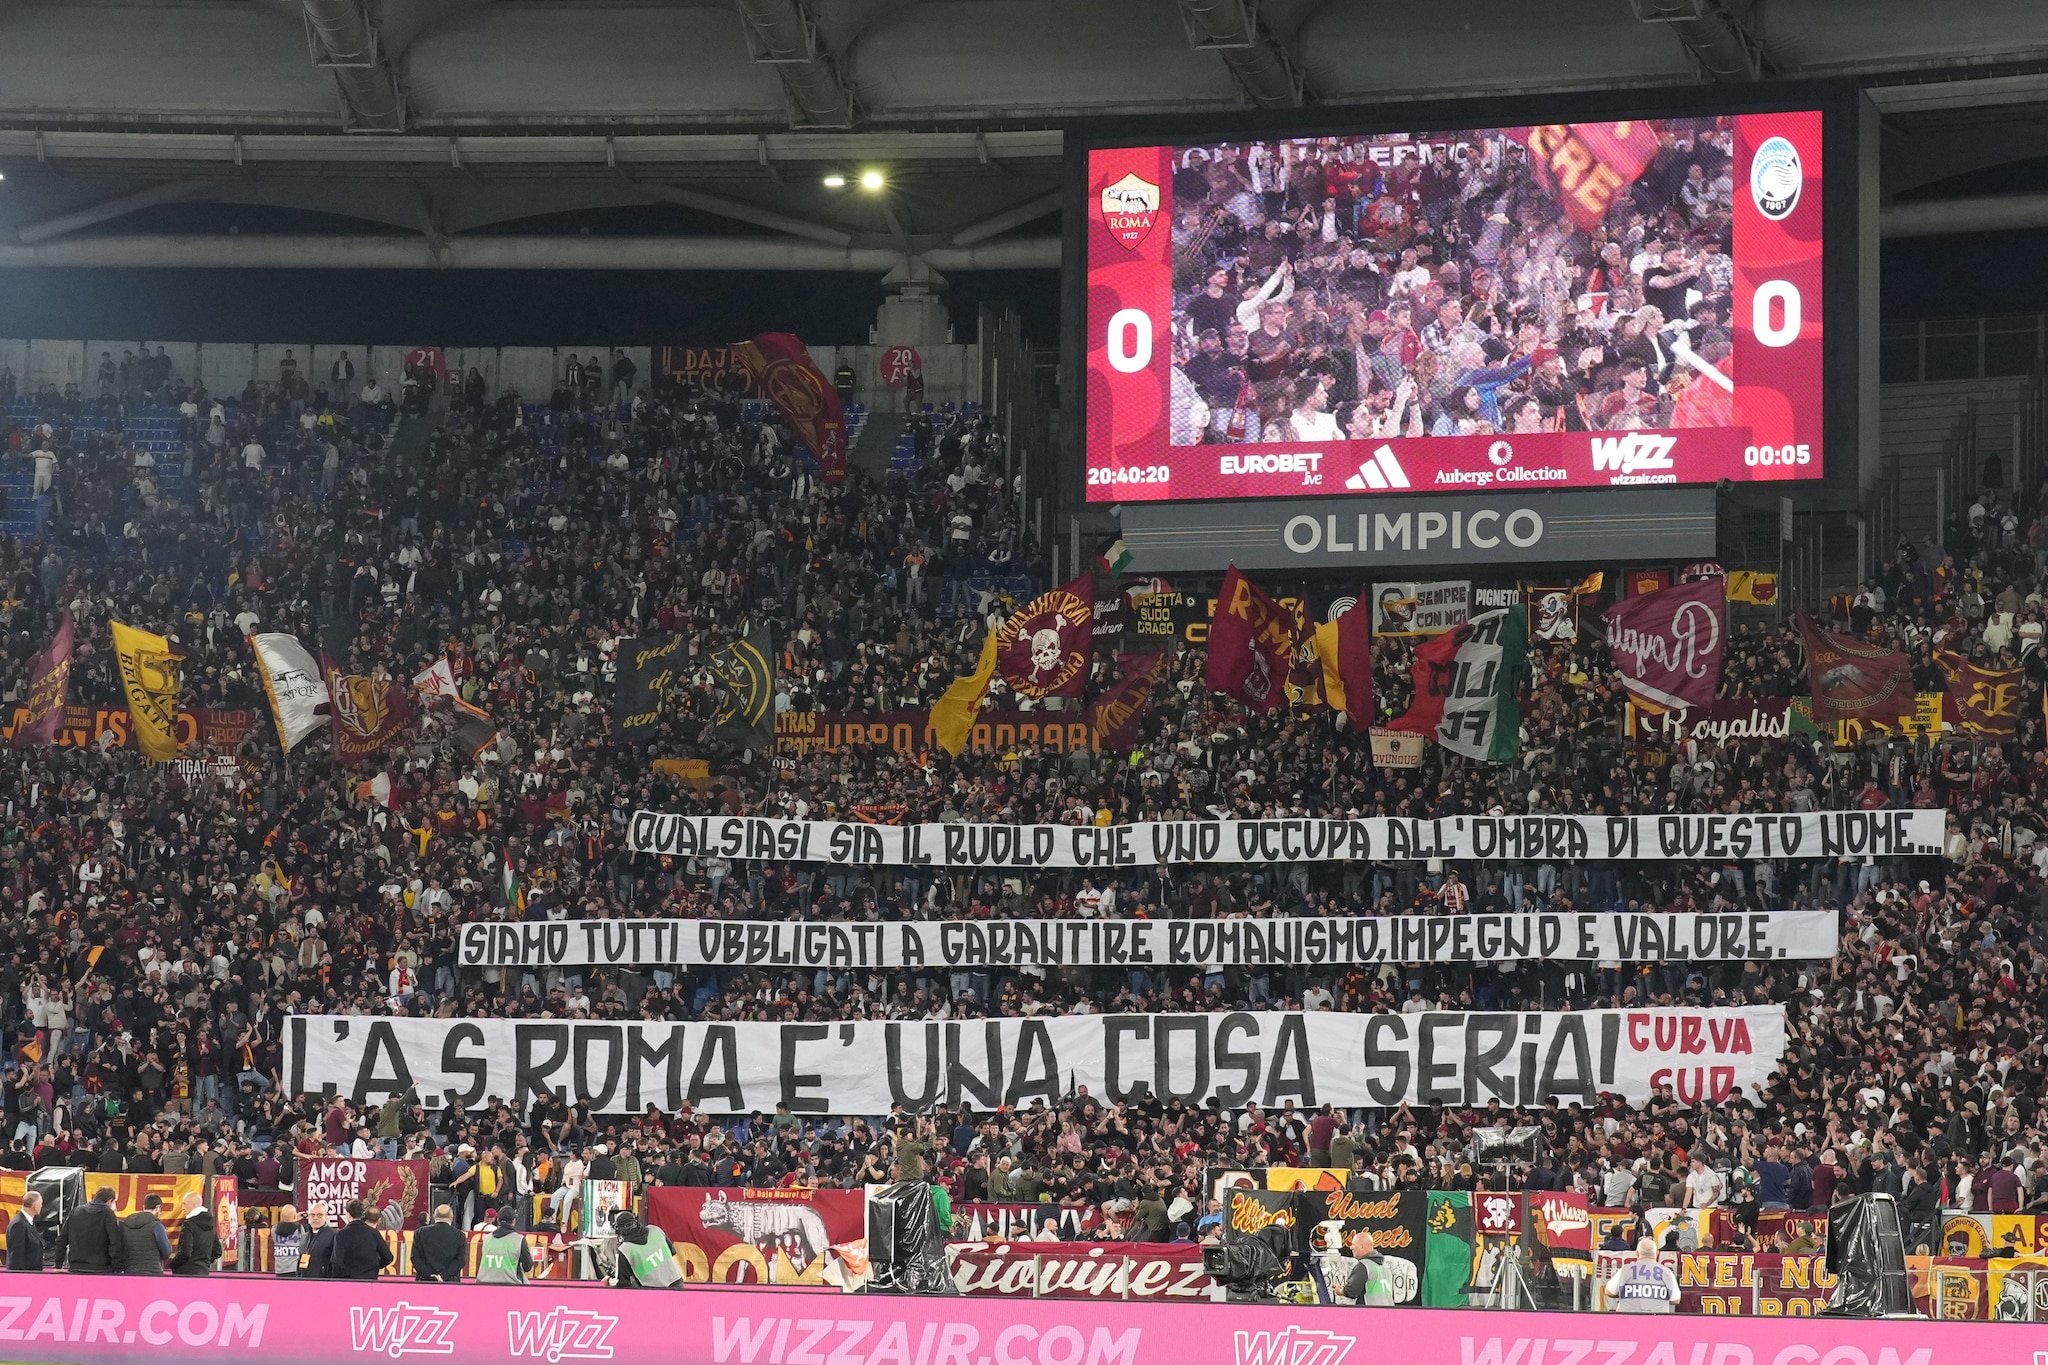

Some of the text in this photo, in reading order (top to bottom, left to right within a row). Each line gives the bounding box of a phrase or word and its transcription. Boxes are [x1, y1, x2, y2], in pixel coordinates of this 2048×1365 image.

[1765, 199, 1787, 210] 1907
[1110, 216, 1151, 229] ROMA
[1752, 281, 1802, 347] 0
[1107, 309, 1153, 374] 0
[417, 350, 435, 367] 21
[892, 349, 912, 366] 20
[1220, 453, 1323, 474] EUROBET
[1744, 445, 1811, 466] 00:05
[1088, 465, 1170, 485] 20:40:20
[1435, 466, 1567, 487] Auberge Collection
[1610, 473, 1676, 486] wizzair.com
[1283, 508, 1544, 554] OLIMPICO
[1416, 586, 1468, 606] SEMPRE
[1475, 588, 1520, 606] PIGNETO
[1140, 607, 1171, 621] SUDO
[1416, 611, 1442, 627] CON
[120, 652, 173, 738] BRIGATA
[283, 684, 318, 701] SPQR
[210, 710, 246, 724] LUCA
[632, 811, 811, 859] QUALSIASI
[829, 824, 884, 864] SIA
[902, 825, 931, 864] IL
[943, 825, 1054, 865] RUOLO
[1071, 826, 1136, 866] CHE
[1152, 822, 1221, 860] UNO
[1237, 820, 1371, 860] OCCUPA
[1387, 817, 1588, 860] ALL'OMBRA
[1606, 816, 1639, 858] DI
[1658, 813, 1803, 857] QUESTO
[464, 923, 569, 965] SIAMO
[580, 922, 678, 963] TUTTI
[700, 923, 884, 967] OBBLIGATI
[901, 923, 925, 961] A
[940, 921, 1153, 965] GARANTIRE
[1576, 915, 1600, 958] E
[1614, 914, 1787, 960] VALORE.
[1627, 1014, 1754, 1055] CURVA
[778, 1022, 857, 1113] E'
[885, 1019, 1062, 1113] UNA
[1103, 1012, 1316, 1111] COSA
[1650, 1065, 1735, 1107] SUD
[308, 1160, 367, 1182] AMOR
[308, 1182, 359, 1199] ROMAE
[604, 1180, 619, 1193] ROMA
[1325, 1190, 1402, 1220] Usual
[1945, 1218, 1975, 1232] WORKING
[486, 1255, 504, 1268] TV
[646, 1249, 666, 1267] TV
[1630, 1264, 1664, 1281] 148
[1679, 1254, 1763, 1289] NEL
[1624, 1284, 1668, 1299] PHOTO
[1701, 1296, 1742, 1315] DI
[712, 1316, 1142, 1365] WIZZAIR.COM
